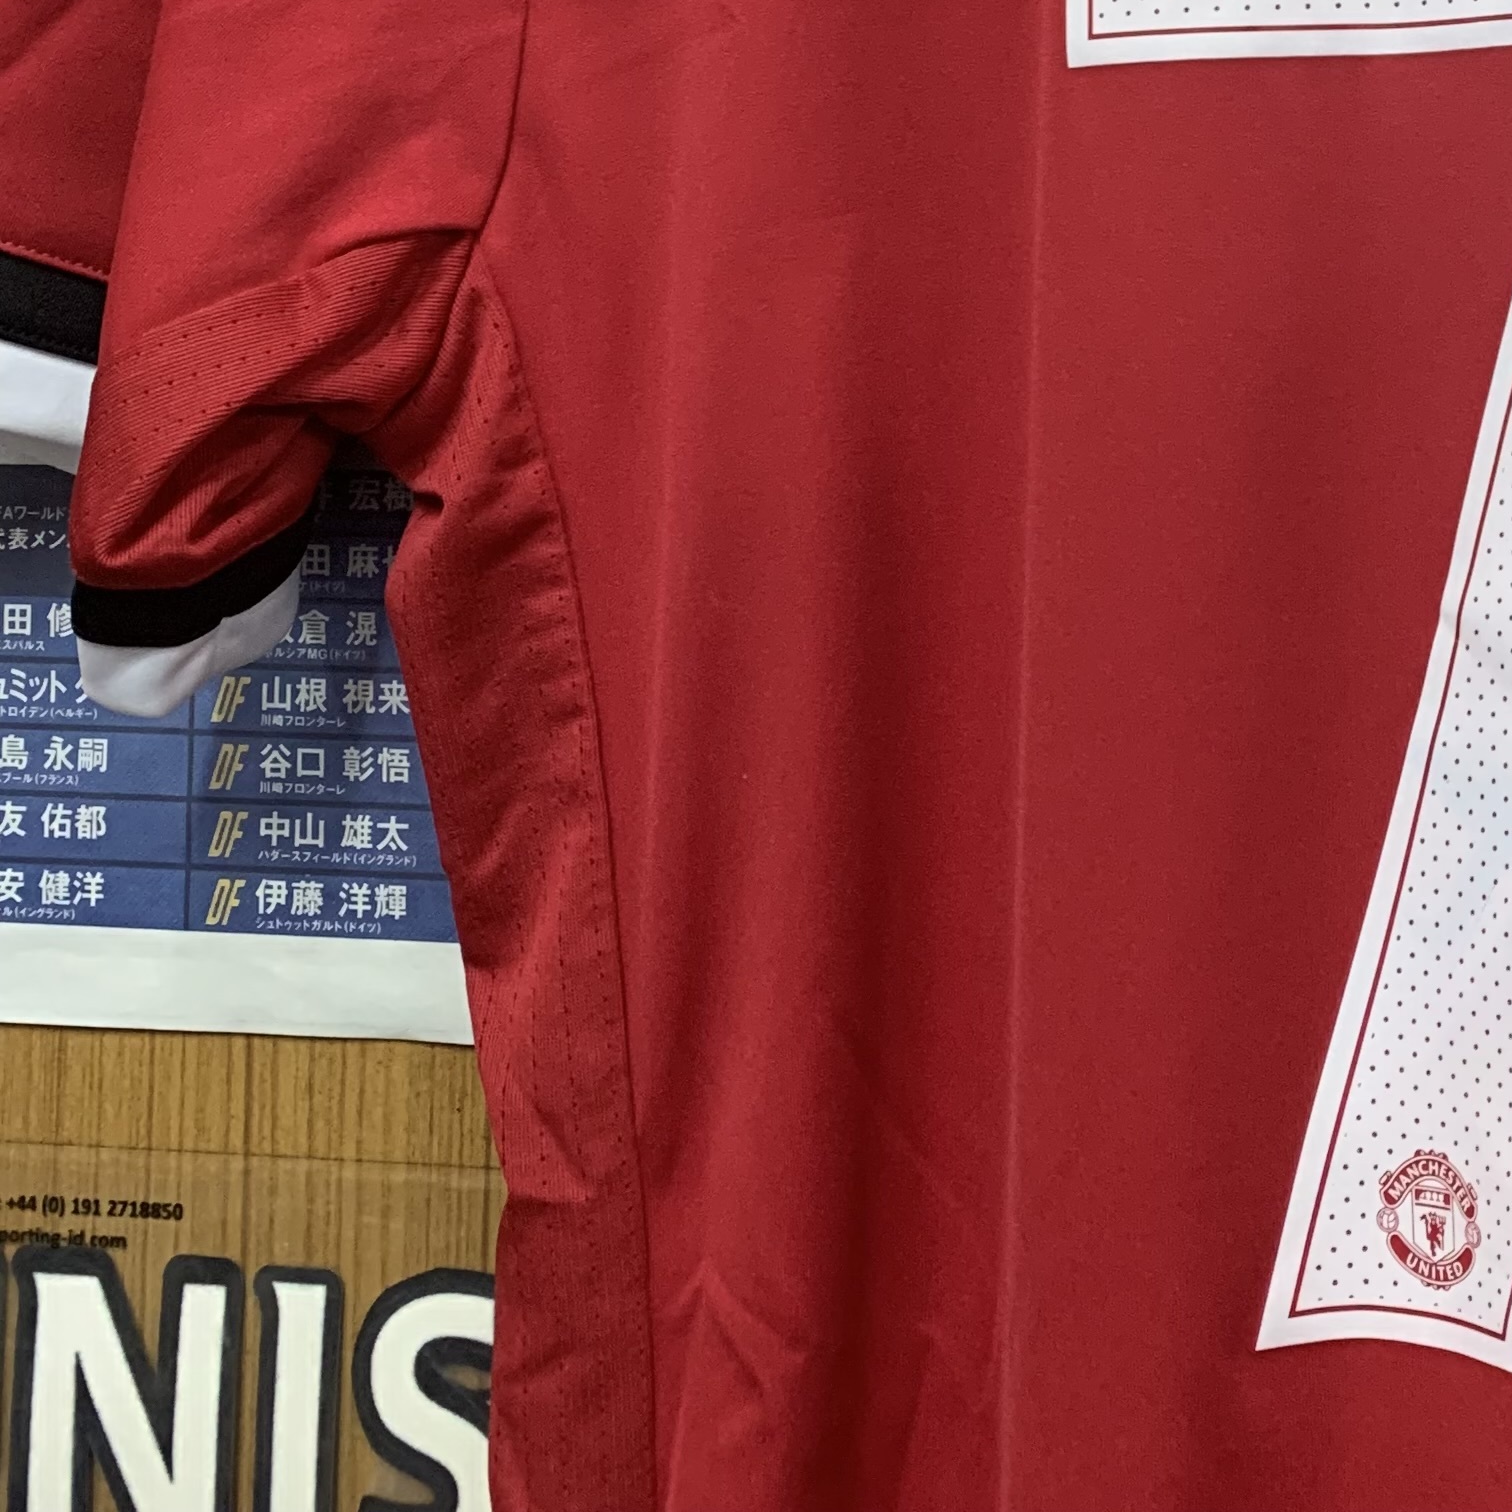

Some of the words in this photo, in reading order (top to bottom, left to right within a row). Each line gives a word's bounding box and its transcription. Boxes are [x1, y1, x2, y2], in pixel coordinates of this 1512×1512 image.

[0, 527, 71, 550] 表メン
[3, 603, 32, 636] 田
[0, 639, 46, 652] スパルス
[210, 676, 252, 724] DF
[261, 676, 327, 714] 山根
[342, 679, 411, 716] 視来
[43, 735, 108, 773] 永嗣
[208, 742, 250, 791] DF
[259, 743, 326, 780] 谷口
[341, 746, 411, 784] 彰悟
[41, 803, 107, 840] 佑都
[207, 810, 249, 859] DF
[259, 811, 325, 849] 中山
[340, 814, 410, 852] 雄太
[38, 869, 105, 907] 健洋
[205, 878, 247, 927] DF
[255, 878, 325, 917] 伊藤
[338, 882, 408, 921] 洋輝
[1387, 1159, 1471, 1213] MANCHESTER
[6, 1194, 38, 1212] +44
[42, 1194, 66, 1217] (0)
[71, 1197, 102, 1216] 191
[106, 1199, 184, 1221] 2718850
[1405, 1252, 1464, 1281] UNITED
